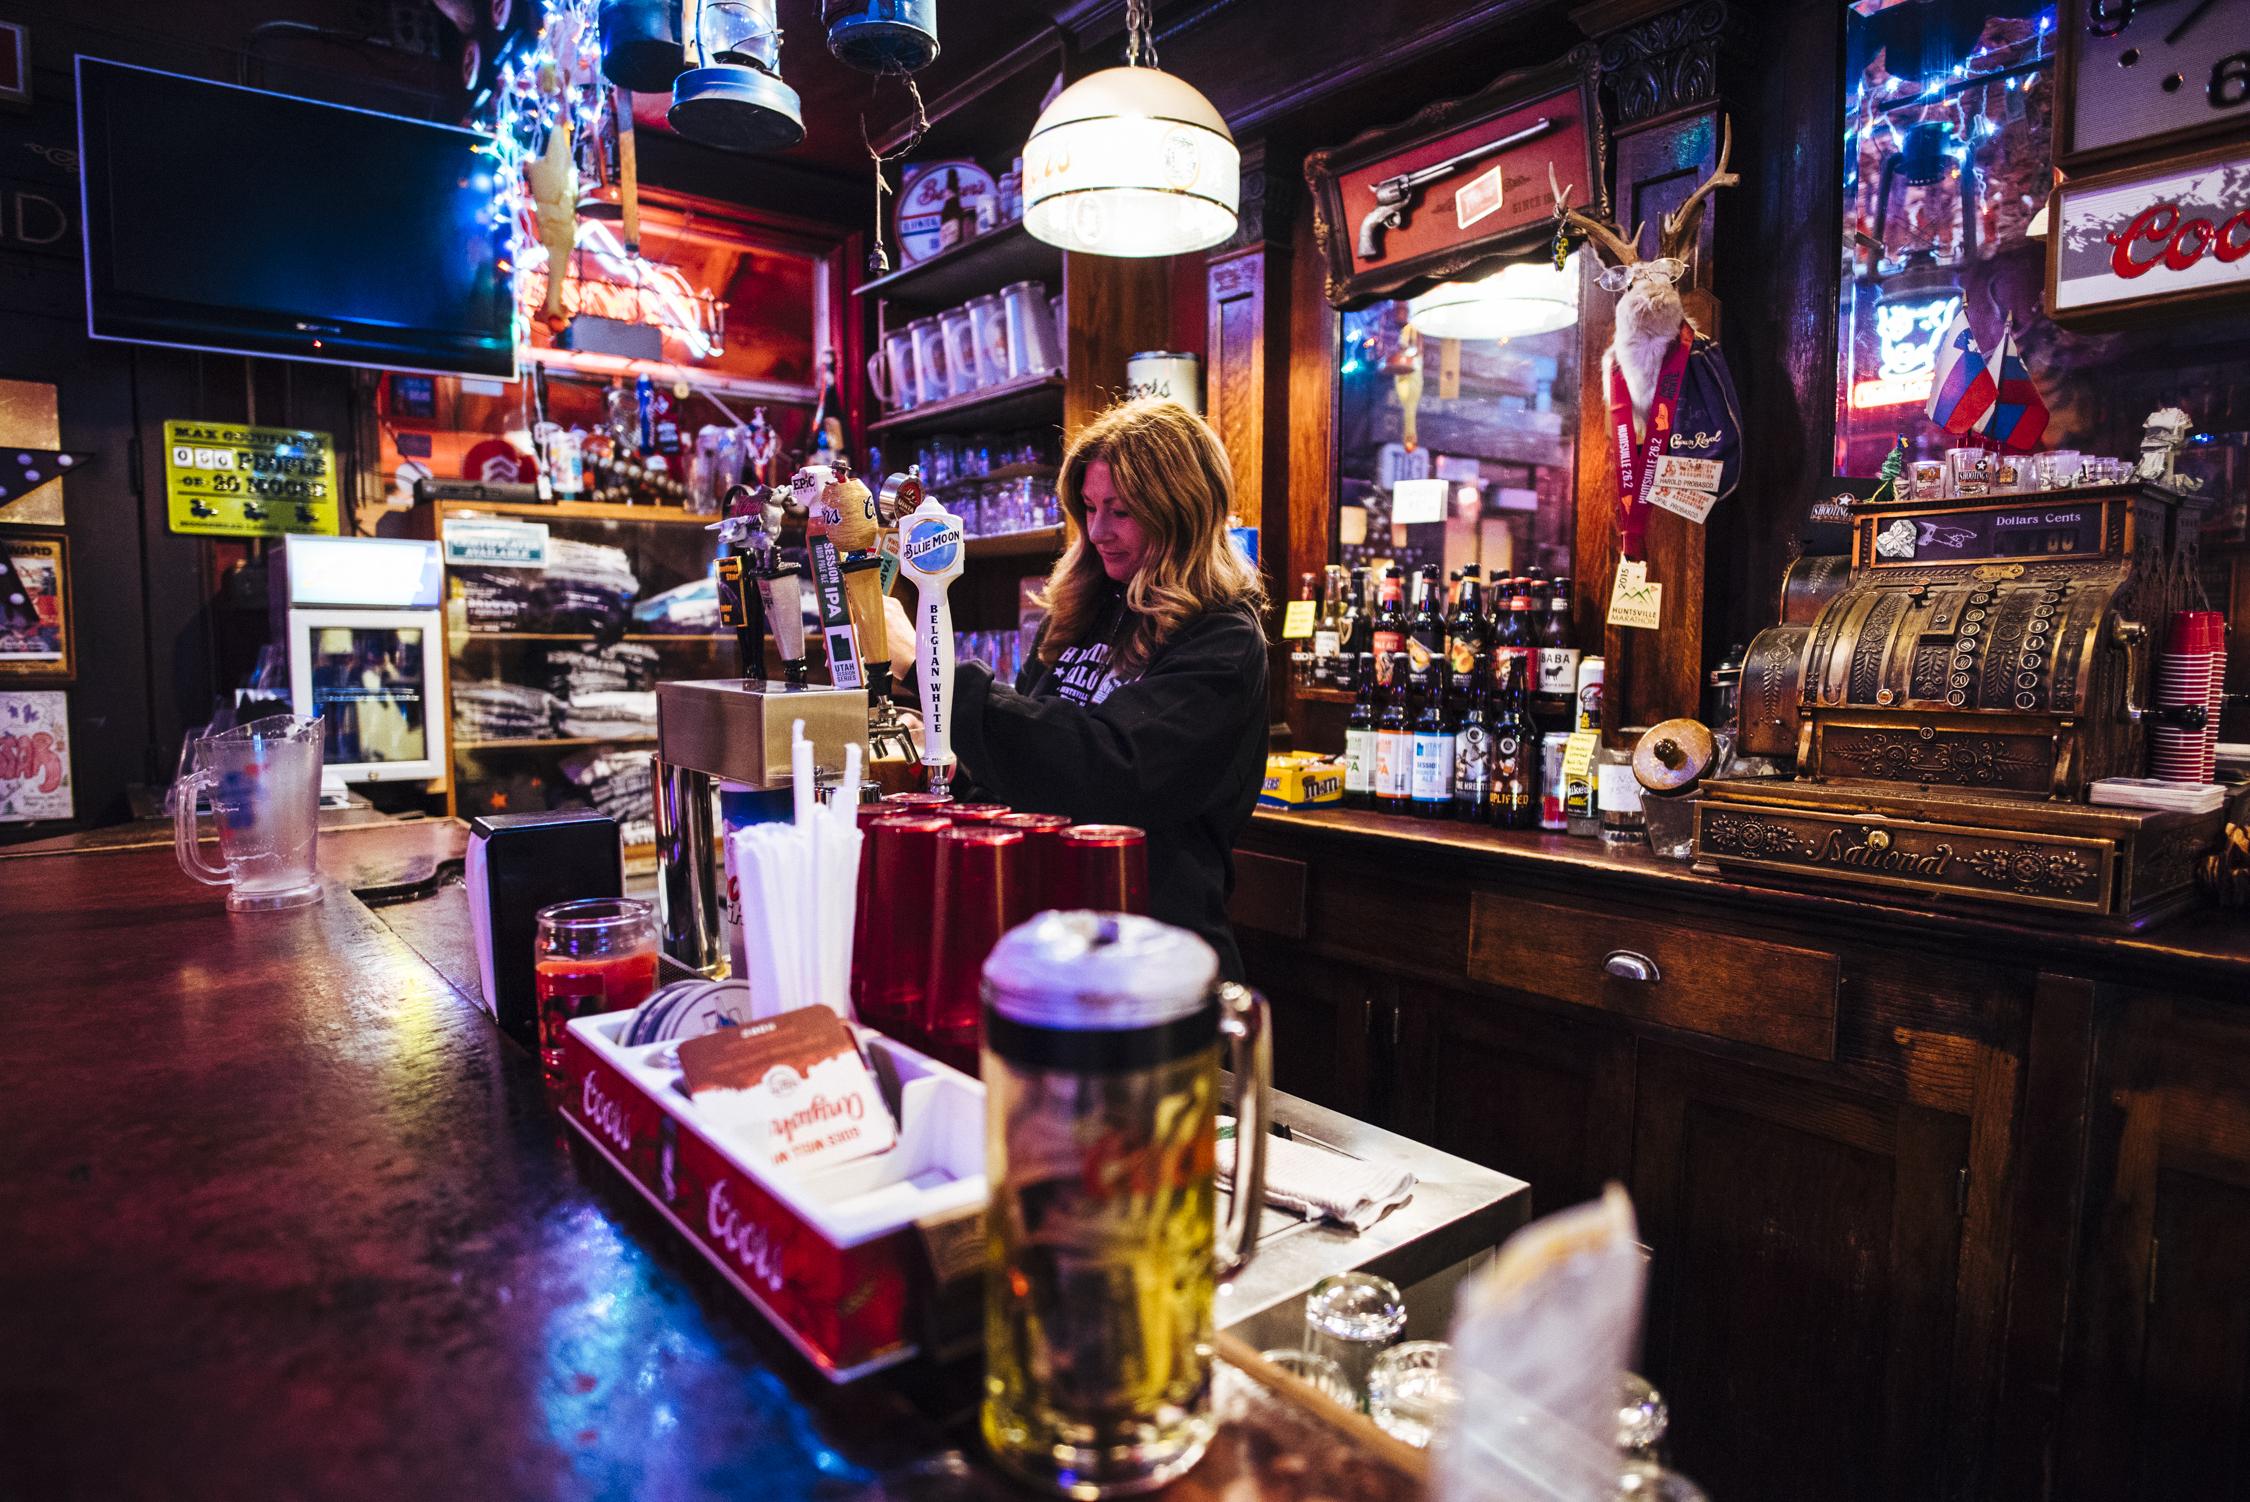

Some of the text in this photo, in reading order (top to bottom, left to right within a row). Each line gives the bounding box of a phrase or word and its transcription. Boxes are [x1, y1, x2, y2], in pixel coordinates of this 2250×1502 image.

[2208, 53, 2250, 108] 6
[1648, 437, 1663, 458] 26.2
[1670, 430, 1722, 449] Crown Royal
[1617, 423, 1634, 488] HUNTSVILLE 26.2
[1996, 512, 2081, 526] Dollars Cents
[903, 530, 960, 560] BLUE MOON
[824, 542, 840, 584] SESSION
[1618, 568, 1630, 590] 2015
[824, 588, 842, 619] IPA
[1612, 606, 1657, 618] HUNTSVILLE
[1610, 614, 1657, 626] MARATHON
[834, 662, 856, 673] UTAH
[930, 604, 942, 733] BELGIAN WHITE
[1541, 652, 1571, 665] BABA
